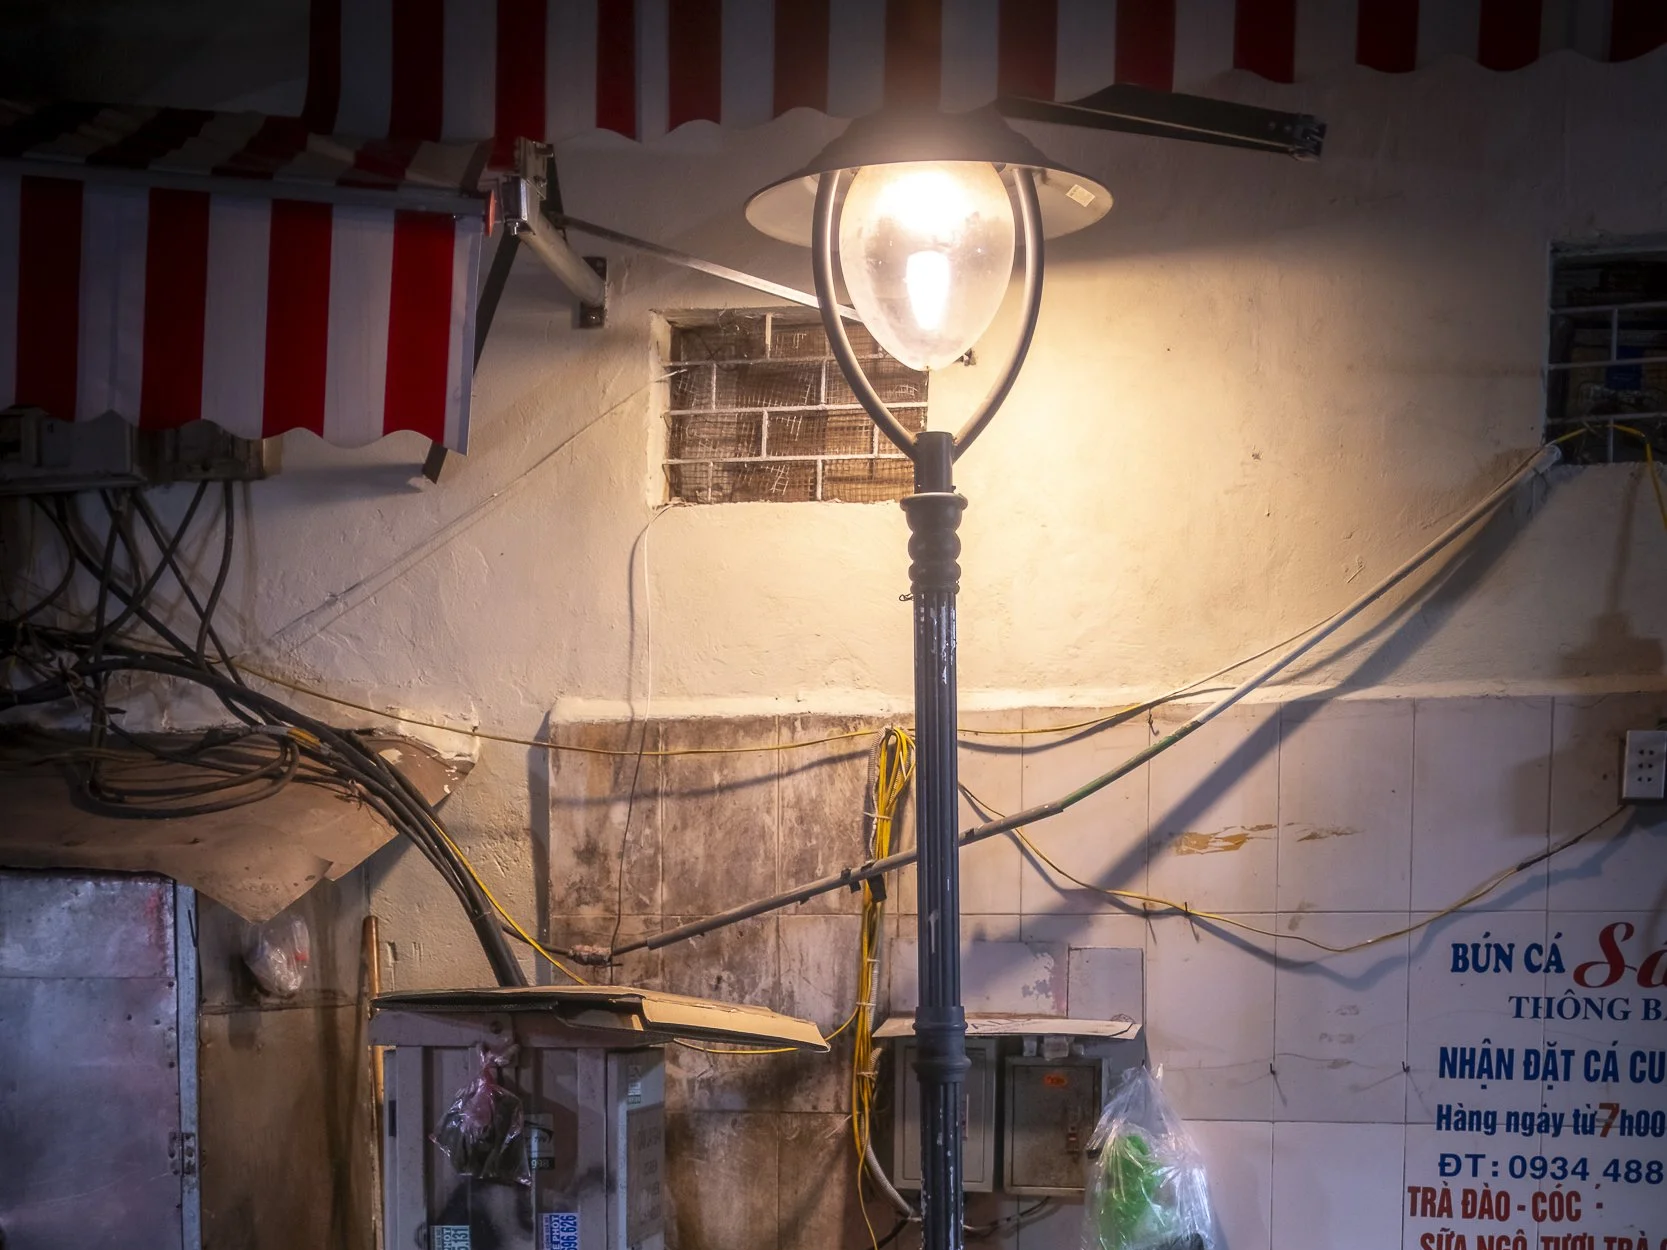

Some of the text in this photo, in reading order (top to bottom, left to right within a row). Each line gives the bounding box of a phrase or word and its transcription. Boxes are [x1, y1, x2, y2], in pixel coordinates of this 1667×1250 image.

[1450, 931, 1515, 974] BÚN
[1523, 931, 1566, 974] CÁ
[1508, 988, 1667, 1021] THÔNG B
[1438, 1038, 1515, 1090] NHẬN
[1523, 1040, 1576, 1091] ĐẶT
[1583, 1040, 1620, 1083] CÁ
[1435, 1102, 1497, 1136] Hàng
[1508, 1154, 1590, 1181] 0934
[1602, 1158, 1665, 1185] 488
[1407, 1180, 1453, 1219] TRÀ
[1460, 1182, 1511, 1222] ĐÀO
[1531, 1183, 1582, 1223] CÓC
